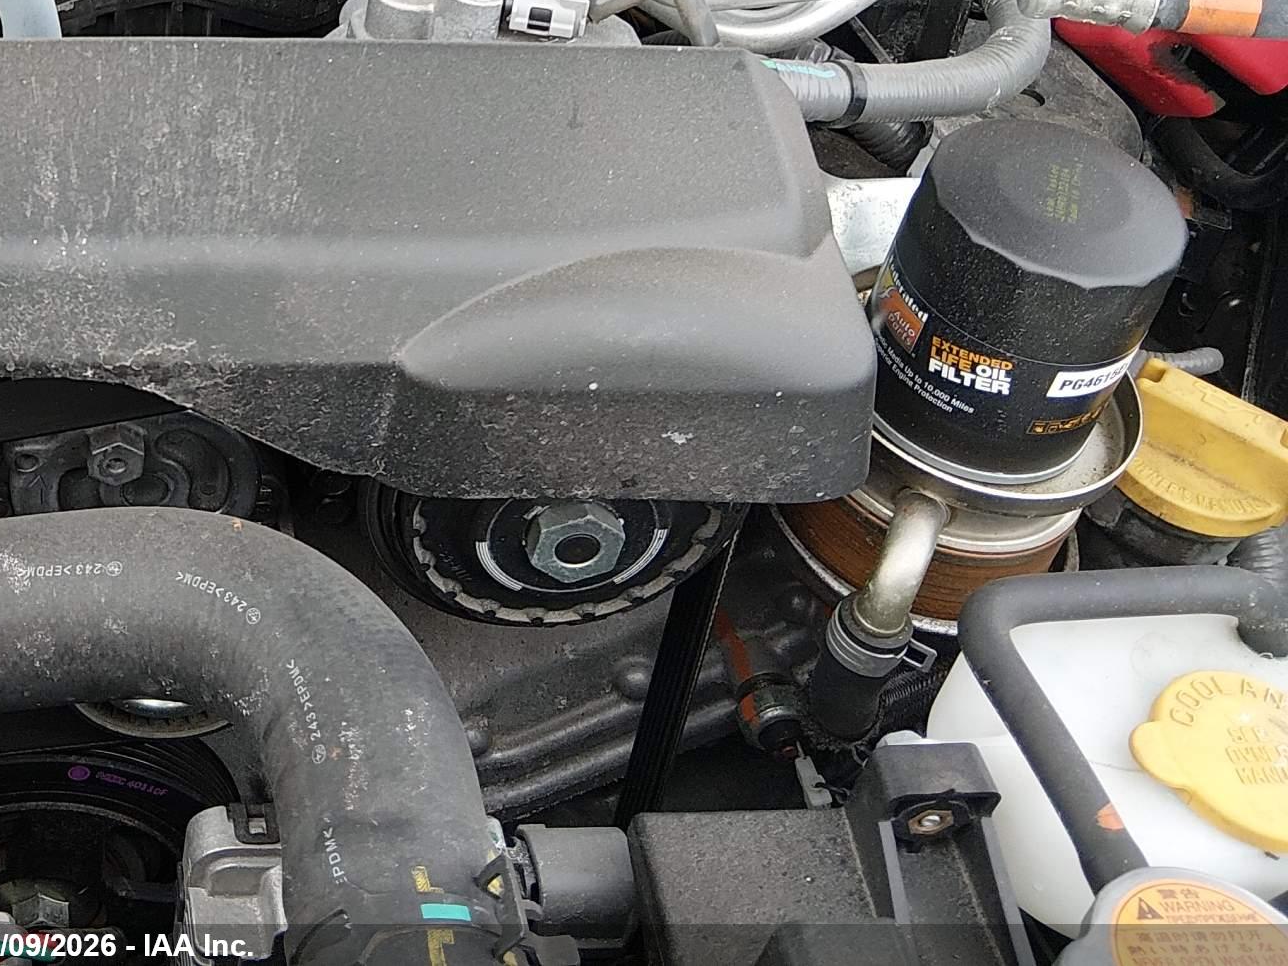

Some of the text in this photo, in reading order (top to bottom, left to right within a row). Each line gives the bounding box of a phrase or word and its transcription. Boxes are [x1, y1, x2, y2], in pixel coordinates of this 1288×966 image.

[893, 310, 915, 337] Auto
[931, 345, 1012, 382] LIFE OIL
[932, 336, 1013, 371] EXTENDED
[892, 362, 913, 388] Engine
[914, 384, 953, 413] Protection
[904, 364, 914, 377] Up
[950, 394, 975, 414] Miles
[928, 357, 1010, 395] FILTER
[76, 562, 102, 576] 243
[223, 591, 248, 613] 243
[1169, 676, 1286, 728] COOLAN
[305, 712, 322, 741] 243
[1160, 900, 1235, 913] WARNING
